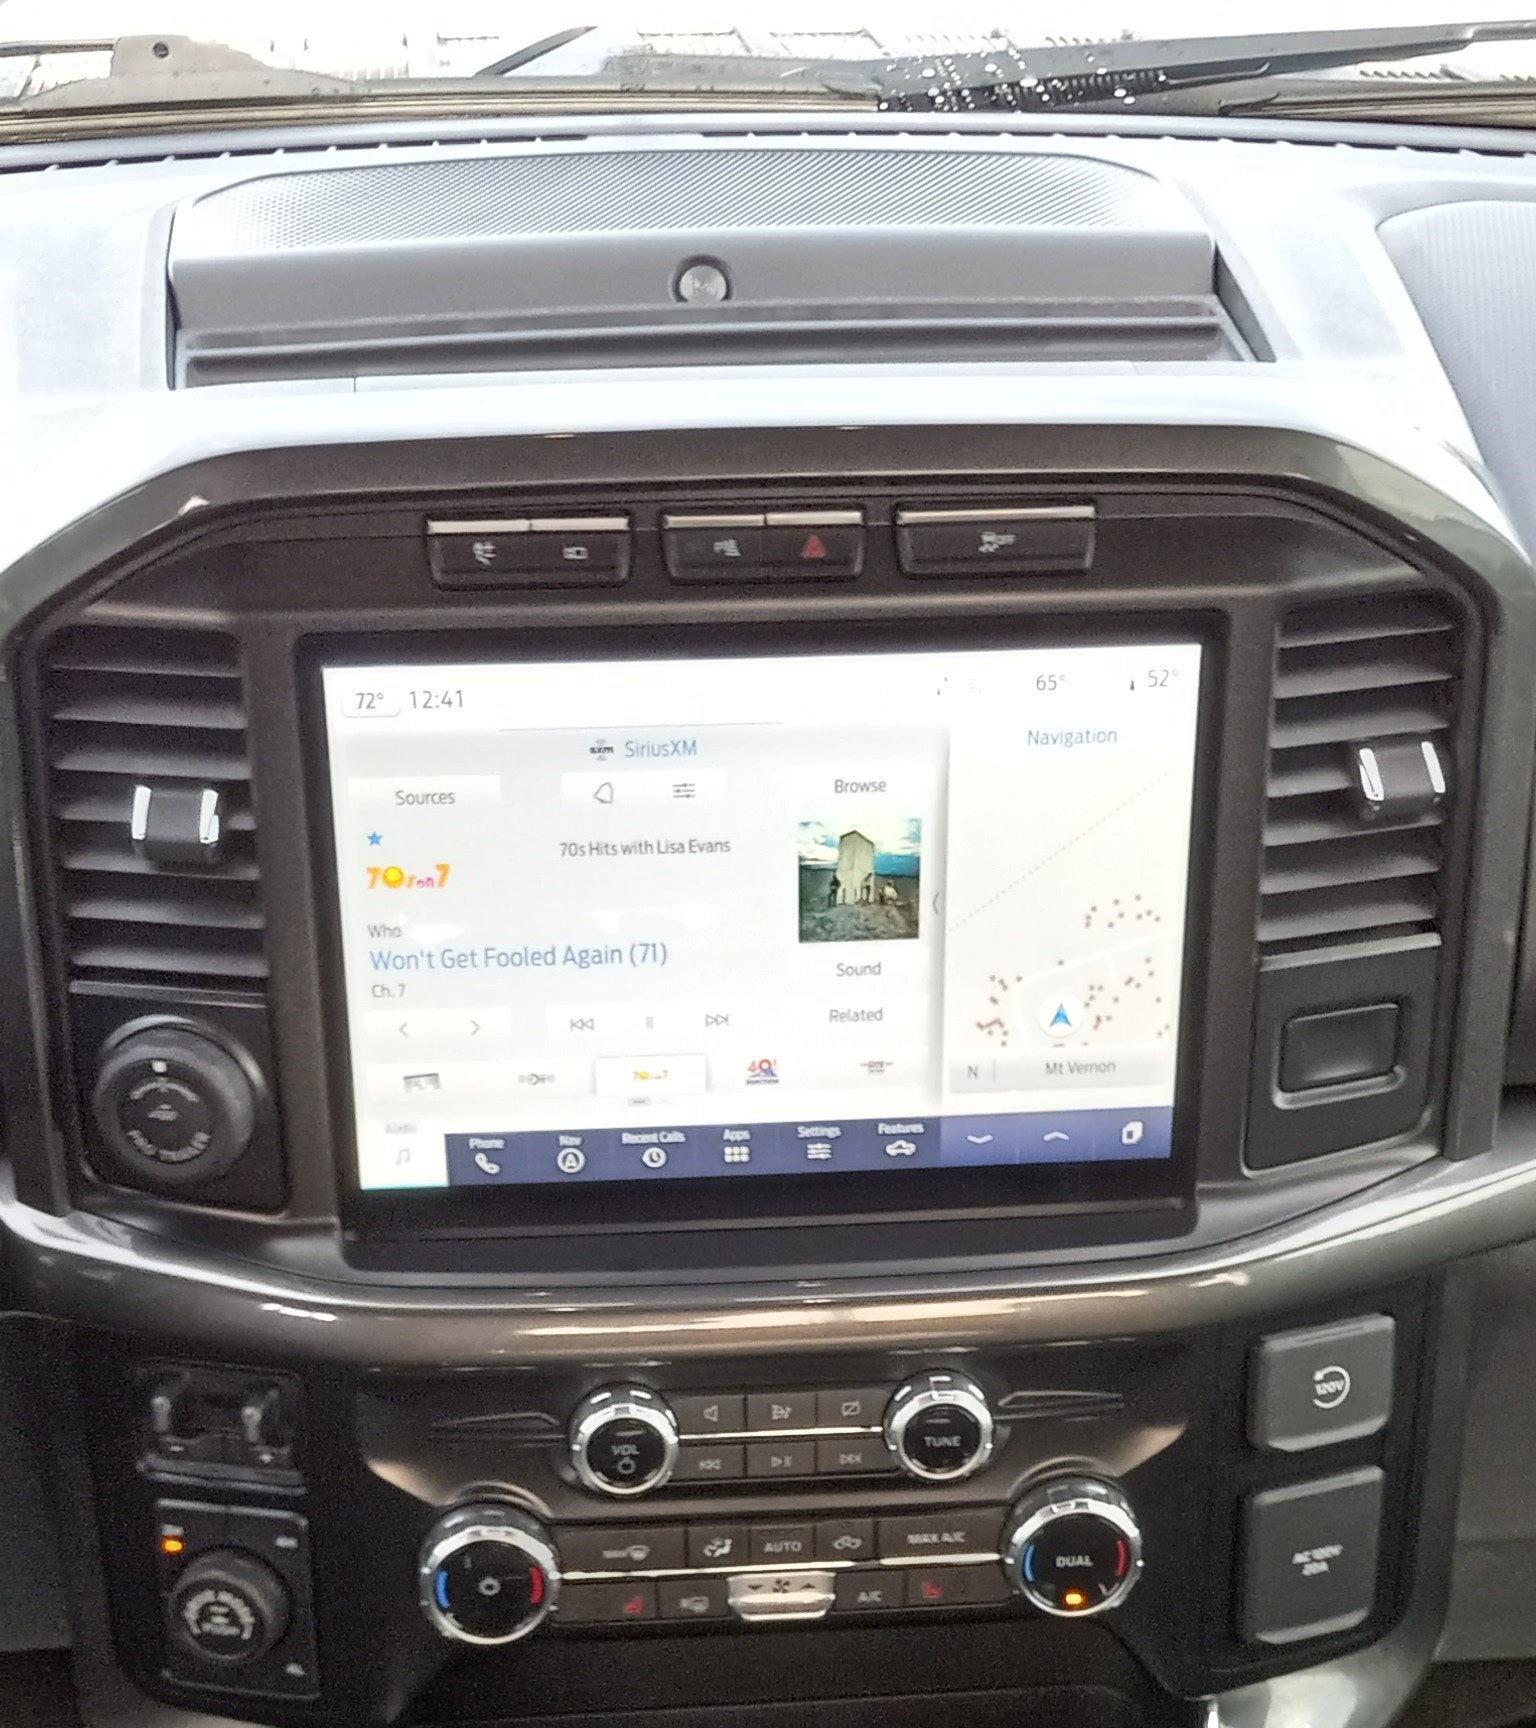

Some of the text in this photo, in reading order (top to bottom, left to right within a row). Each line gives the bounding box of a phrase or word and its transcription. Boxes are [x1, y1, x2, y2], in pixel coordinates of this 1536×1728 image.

[1148, 669, 1179, 688] 52°
[355, 689, 463, 709] 72° 12:41
[1027, 727, 1118, 748] Navigation
[624, 739, 699, 758] SiriusXM
[834, 778, 887, 795] Browse
[395, 789, 456, 806] Sources
[560, 837, 731, 858] 70s Hits with Lisa Evans
[367, 924, 402, 939] Who
[370, 942, 669, 972] Won't Get Fooled Again (71)
[836, 961, 882, 977] Sound
[371, 983, 407, 999] Ch. 7
[829, 1007, 883, 1023] Related
[967, 1059, 1117, 1079] N Mt Vernon
[723, 1129, 752, 1143] Apps
[797, 1124, 841, 1140] Settings
[877, 1122, 924, 1137] Features
[469, 1138, 505, 1151] Phone
[611, 1444, 640, 1456] VOL
[924, 1436, 962, 1448] TUNE
[764, 1541, 802, 1553] AUTO
[1055, 1554, 1094, 1568] DUAL
